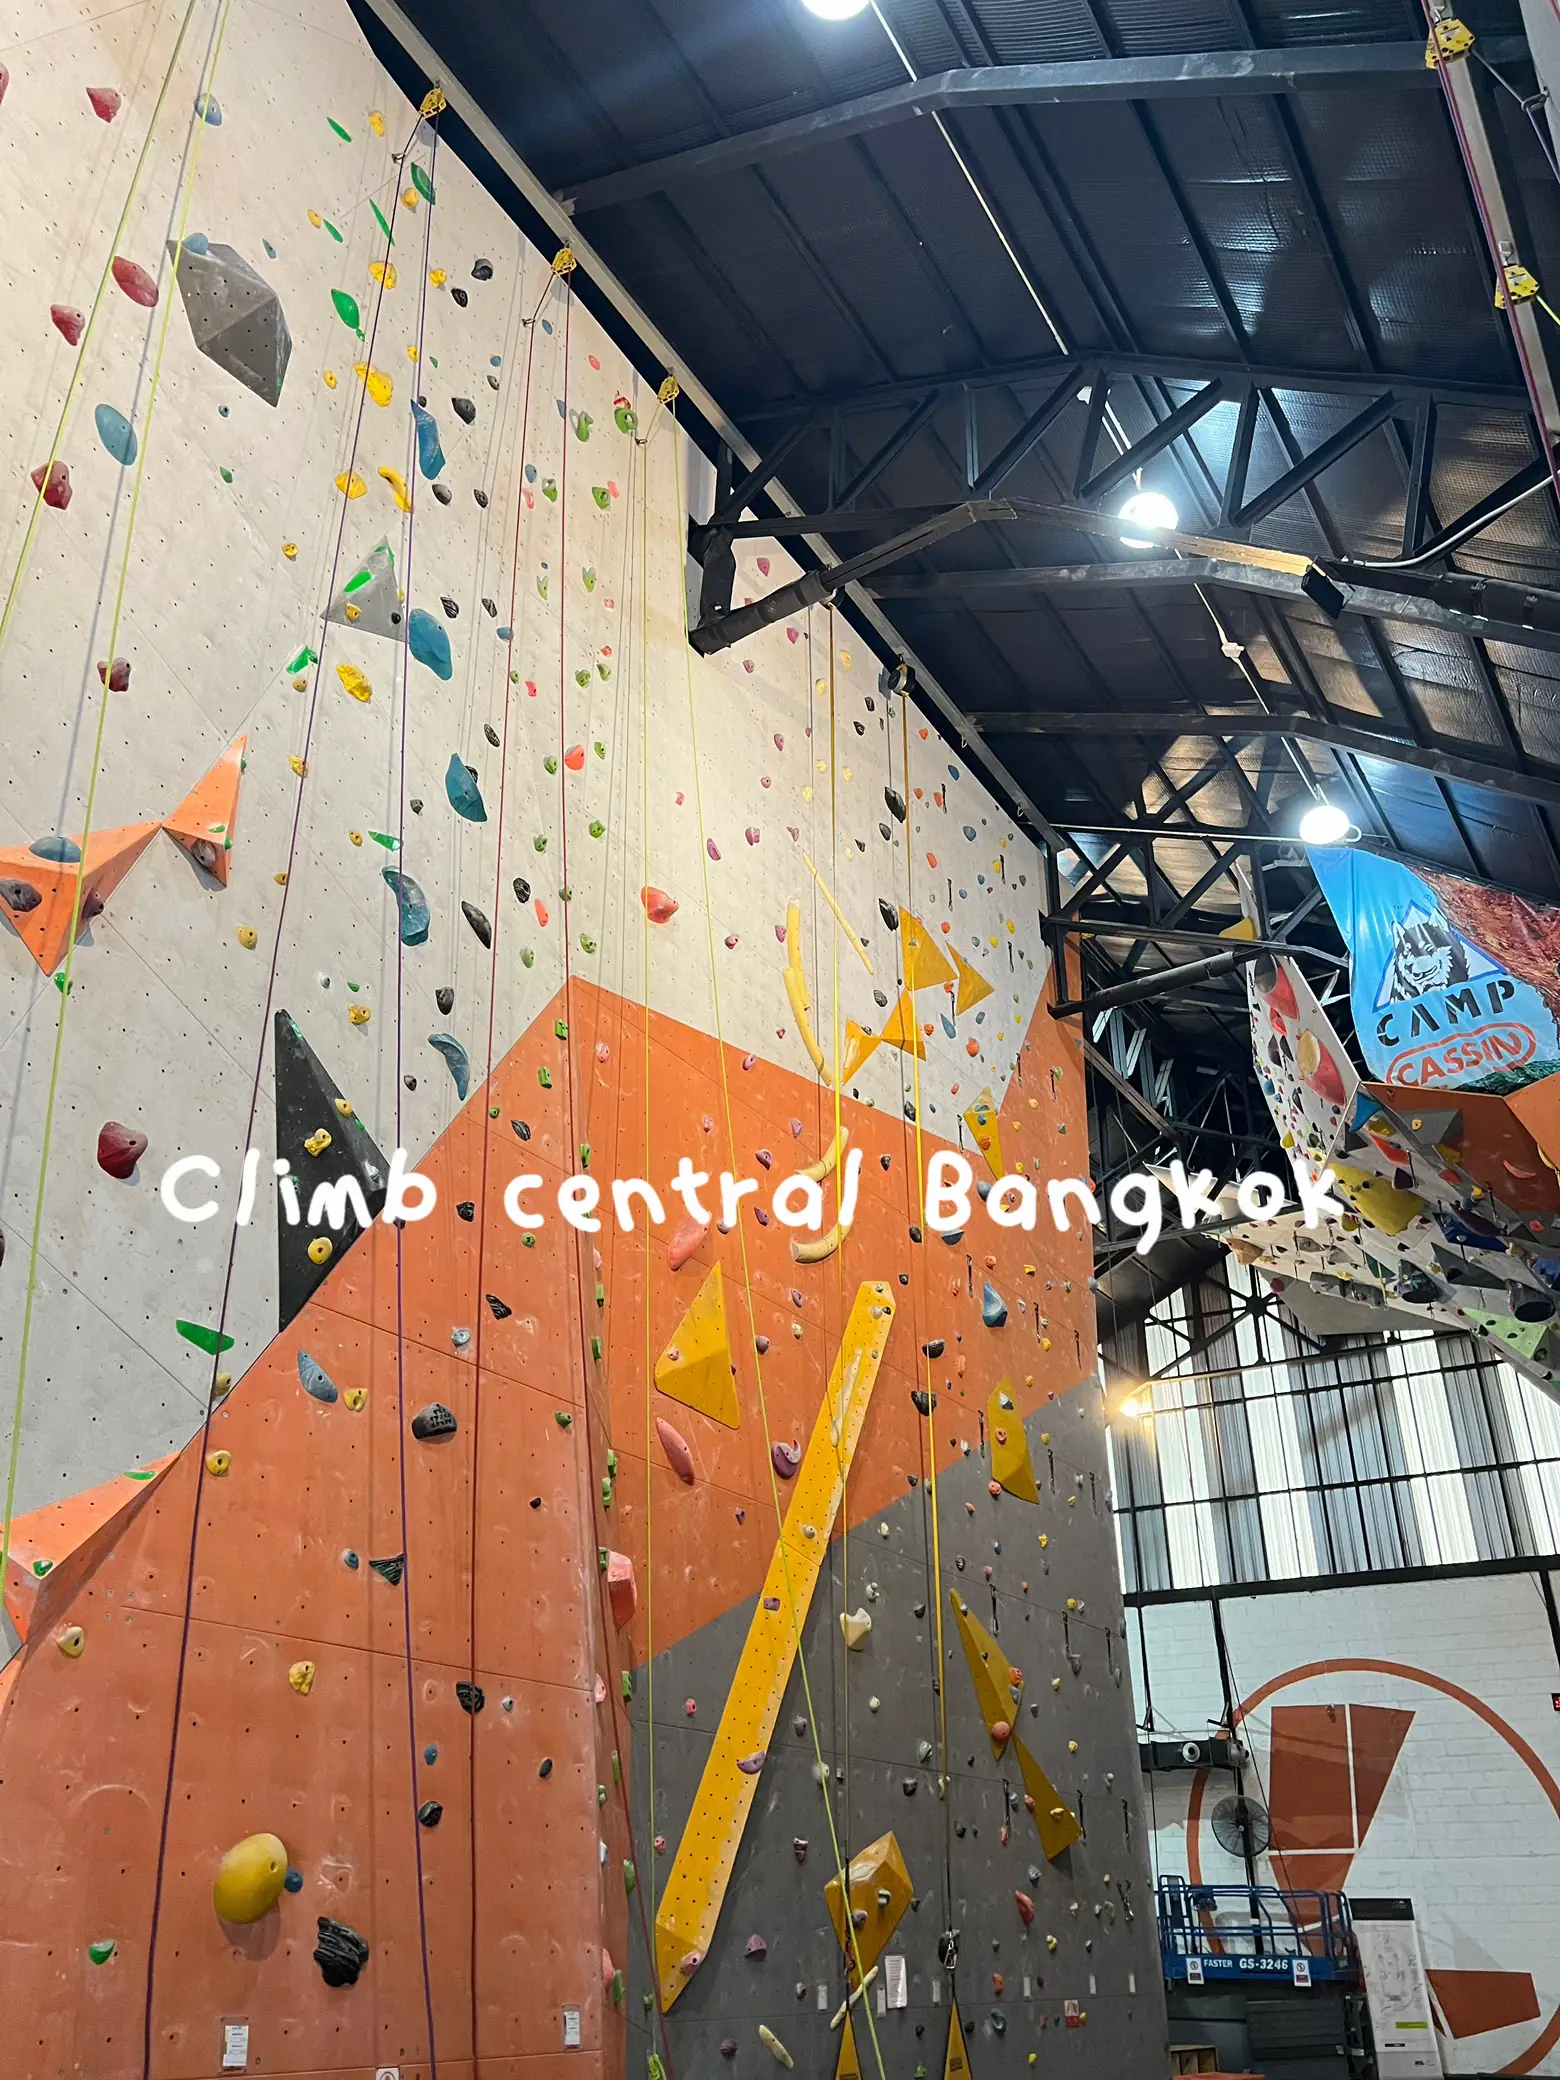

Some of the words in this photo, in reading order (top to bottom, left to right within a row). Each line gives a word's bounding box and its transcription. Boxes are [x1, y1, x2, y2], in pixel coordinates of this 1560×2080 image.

[1376, 980, 1515, 1047] CAMP
[1397, 1031, 1523, 1087] CASSIN
[1203, 1959, 1233, 1968] FASTER
[1239, 1957, 1289, 1970] GS-3246
